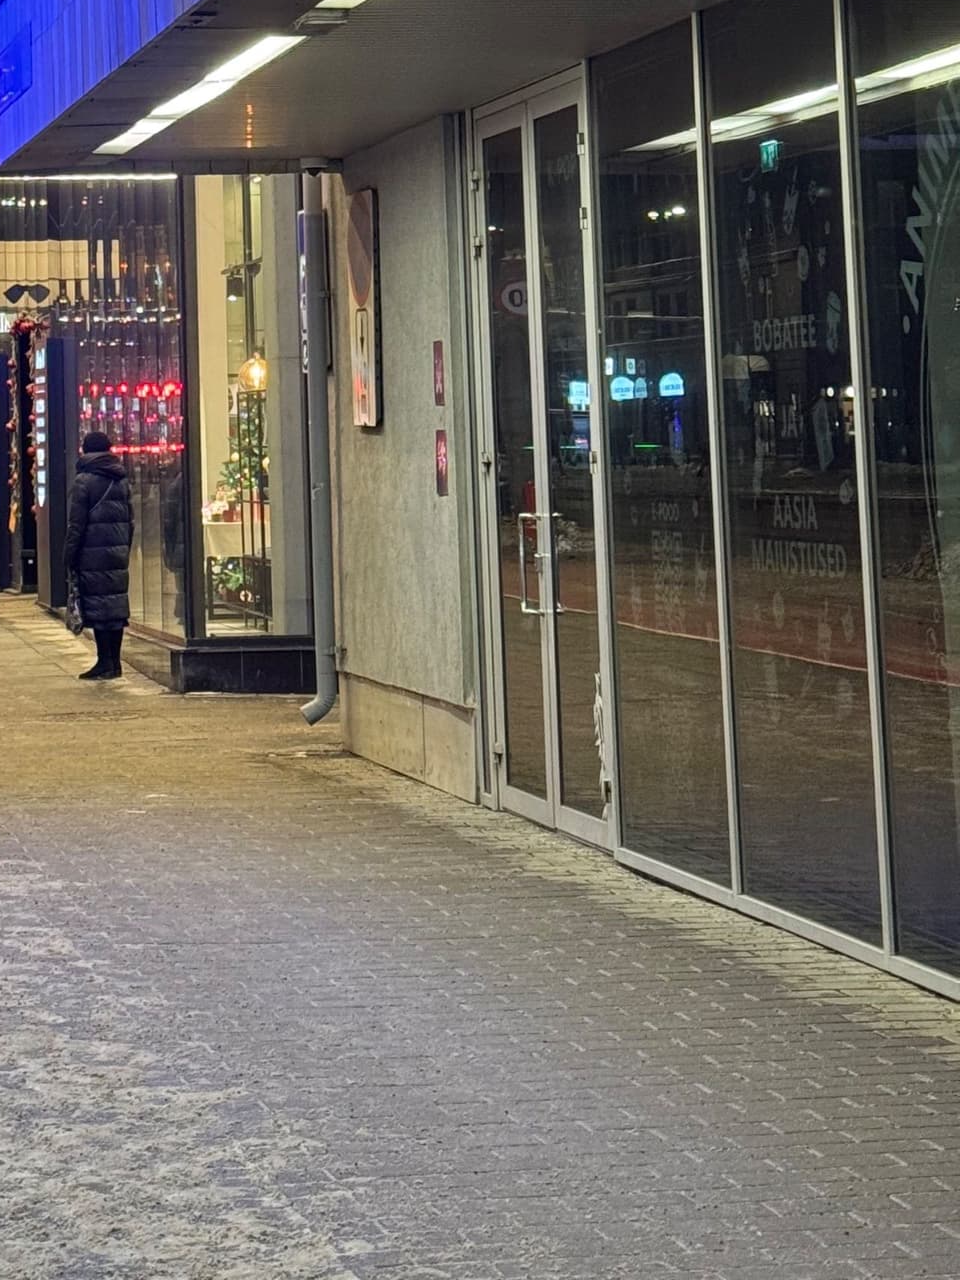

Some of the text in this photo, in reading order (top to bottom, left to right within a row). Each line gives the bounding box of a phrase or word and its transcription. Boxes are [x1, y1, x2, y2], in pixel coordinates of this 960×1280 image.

[753, 314, 817, 352] BOBATEE
[773, 494, 818, 530] AASIA
[751, 539, 847, 578] MAIUSTUSED
